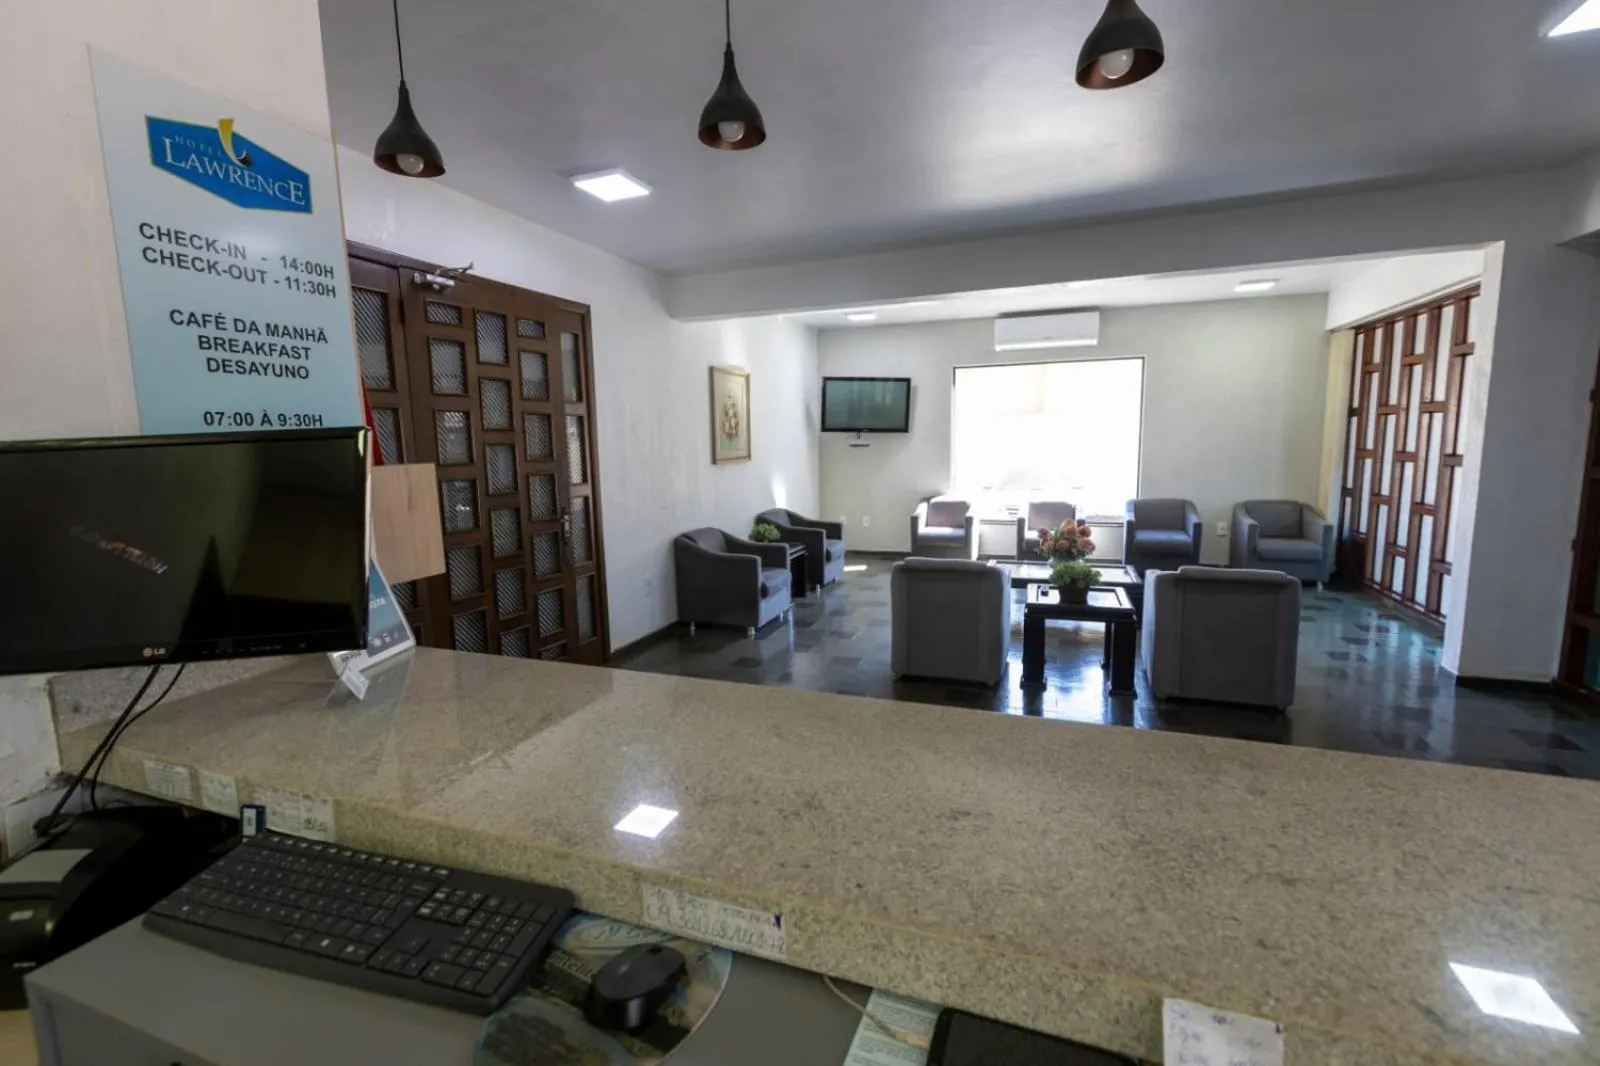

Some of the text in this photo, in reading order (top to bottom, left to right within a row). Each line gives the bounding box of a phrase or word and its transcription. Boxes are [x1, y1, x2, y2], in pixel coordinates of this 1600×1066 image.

[174, 134, 224, 159] HOTEL
[162, 136, 306, 206] LAWRENCE
[139, 222, 247, 260] CHECK-IN
[279, 254, 335, 280] 14:00H
[142, 246, 268, 285] CHECK-OUT
[285, 276, 336, 298] 11:30H
[169, 309, 329, 344] CAFÉ DA MANHÃ
[197, 335, 312, 361] BREAKFAST
[206, 358, 309, 379] DESAYUNO
[203, 409, 323, 427] 07:00 À 9:30H
